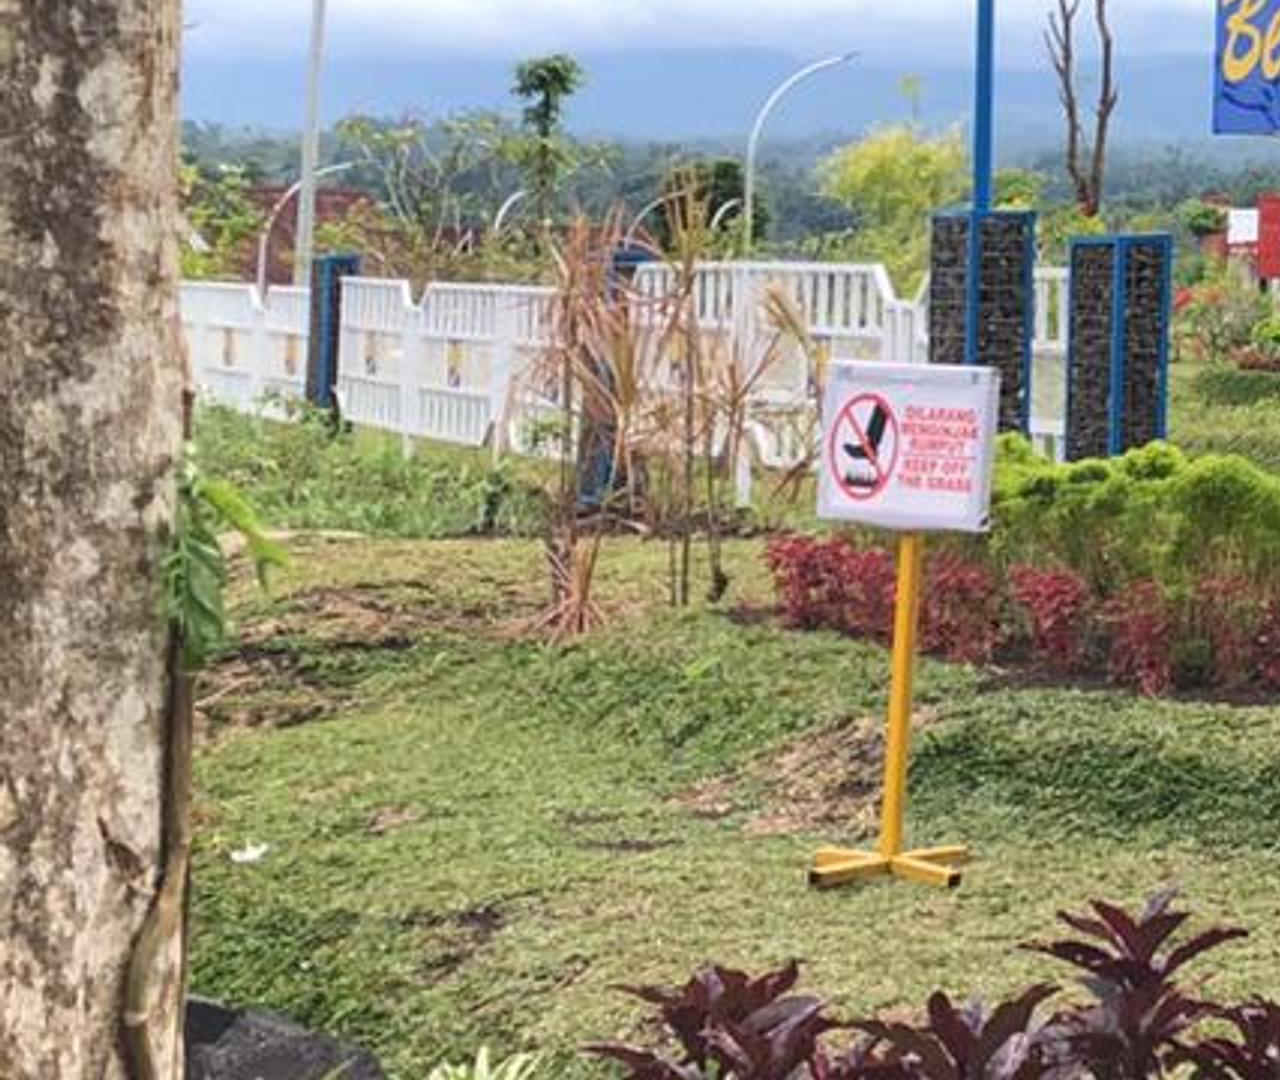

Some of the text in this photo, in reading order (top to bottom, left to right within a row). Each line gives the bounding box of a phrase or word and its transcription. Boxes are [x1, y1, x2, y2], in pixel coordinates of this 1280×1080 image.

[904, 458, 968, 475] KEEP OFF
[897, 473, 972, 494] THE GRASS
